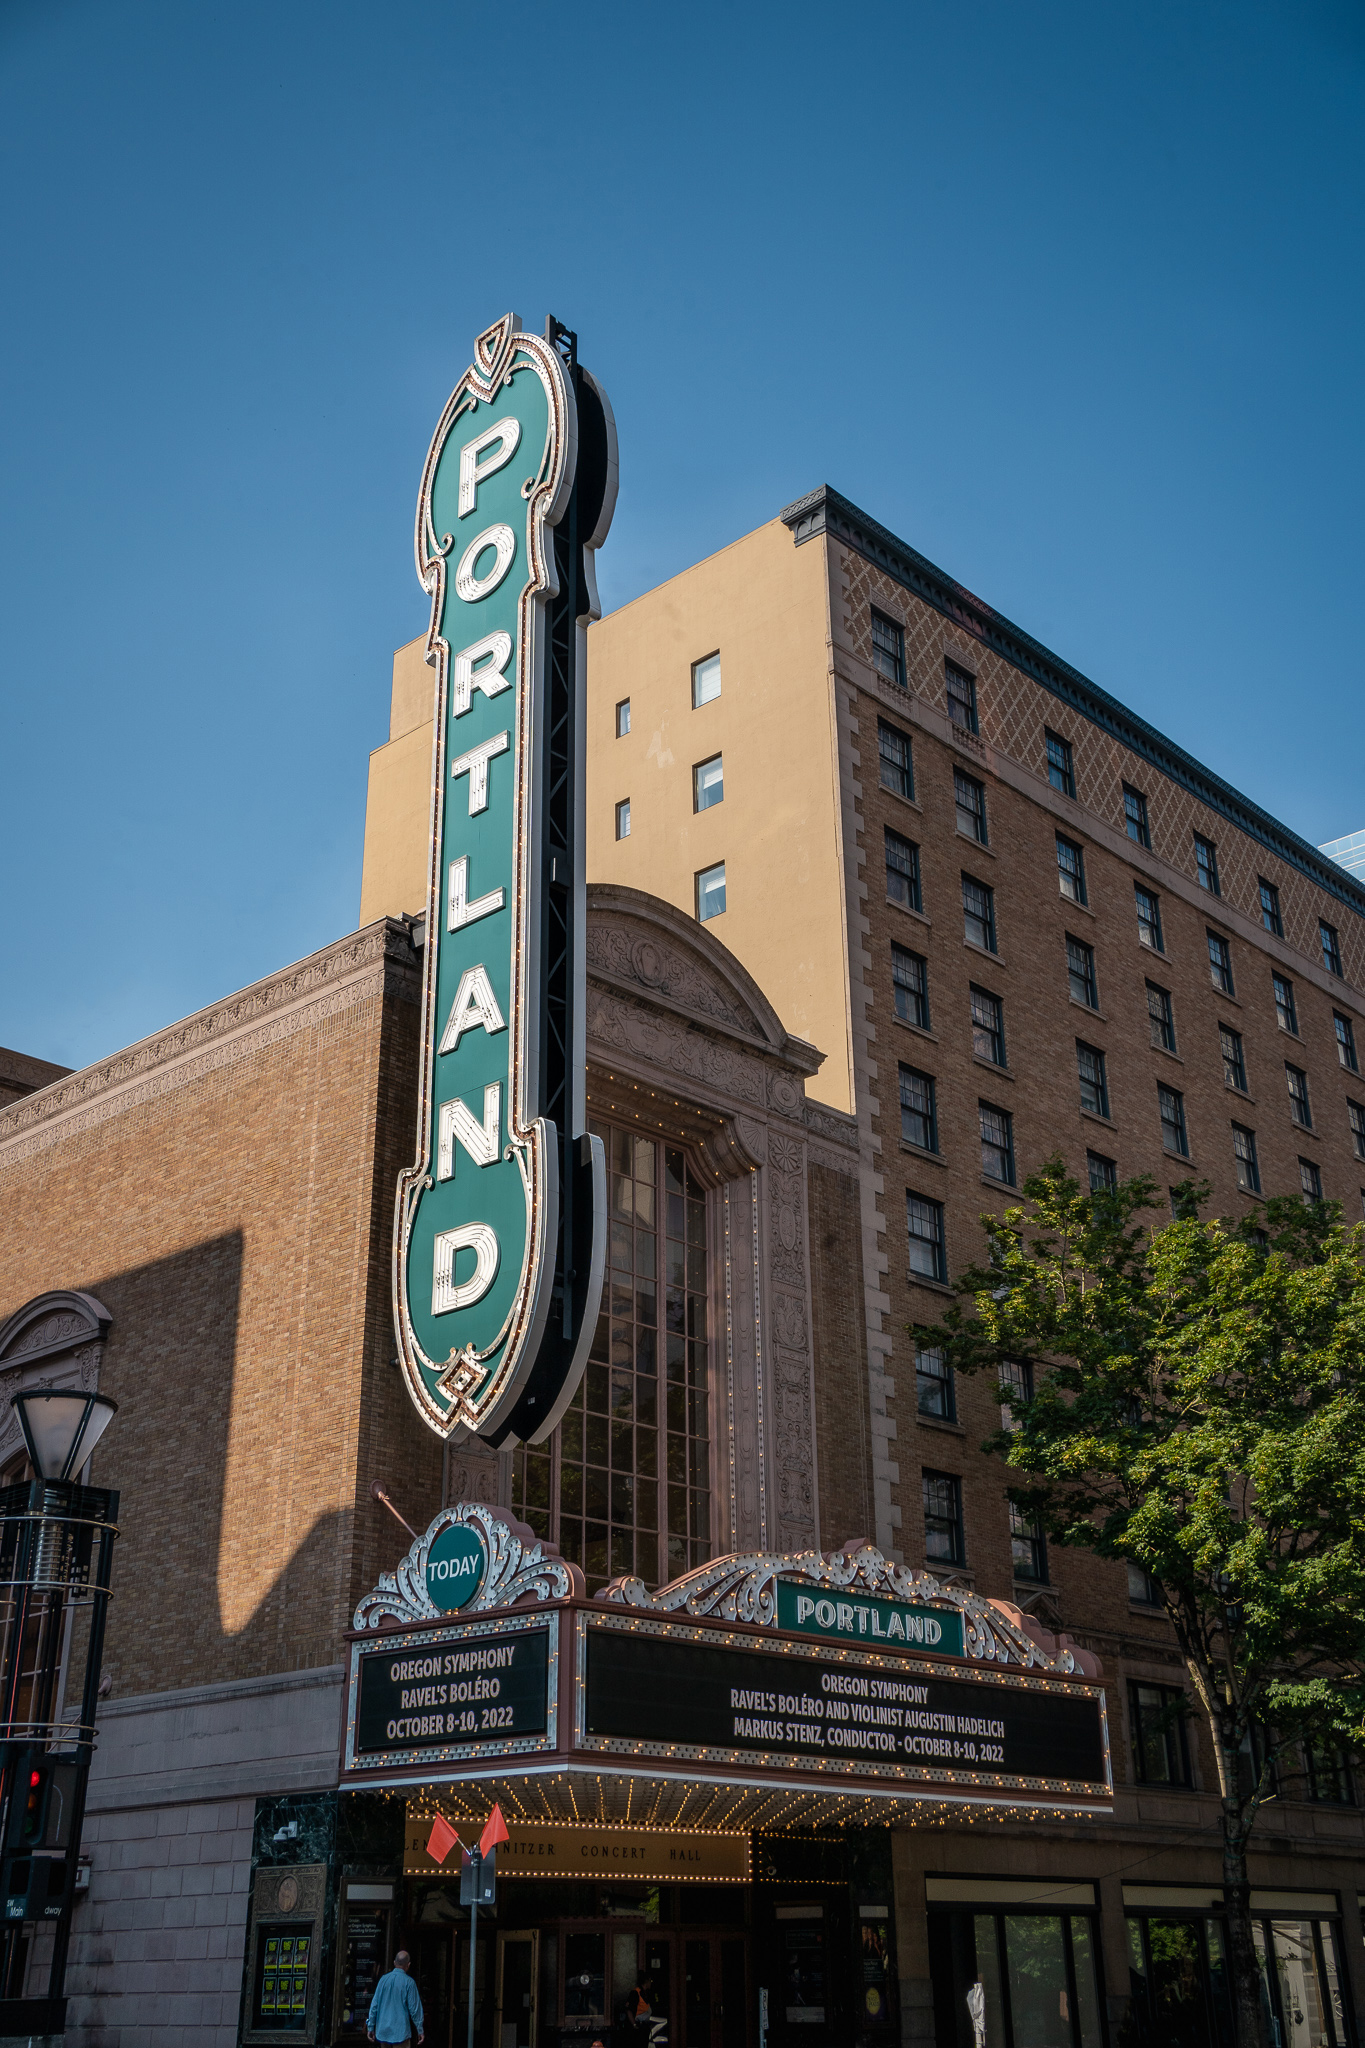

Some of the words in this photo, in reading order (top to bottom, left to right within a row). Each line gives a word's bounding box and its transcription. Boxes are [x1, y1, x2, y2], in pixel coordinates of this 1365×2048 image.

[430, 416, 522, 1315] PORTLAND
[428, 1553, 480, 1581] TODAY
[797, 1595, 943, 1645] PORTLAND
[390, 1656, 442, 1682] OREGON
[443, 1646, 515, 1674] SYMPHONY
[401, 1684, 447, 1709] RAVEL'S
[449, 1675, 500, 1702] BOLÉRO
[821, 1673, 869, 1697] OREGON
[870, 1680, 928, 1704] SYMPHONY
[387, 1714, 444, 1739] OCTOBER
[446, 1711, 478, 1733] 8-10,
[481, 1706, 513, 1729] 2022
[730, 1688, 776, 1712] RAVEL'S
[778, 1692, 824, 1718] BOLÉRO
[826, 1701, 849, 1720] AND
[851, 1704, 903, 1728] VIOLINIST
[905, 1710, 955, 1733] AUGUSTIN
[957, 1716, 1005, 1738] HADELICH
[734, 1717, 783, 1741] MARKUS
[785, 1723, 825, 1747] STENZ,
[827, 1727, 896, 1752] CONDUCTOR
[904, 1738, 951, 1757] OCTOBER
[953, 1741, 979, 1762] 8-10,
[980, 1745, 1004, 1763] 2022
[580, 1845, 646, 1860] CONCERT
[670, 1848, 701, 1861] HALL
[10, 1906, 23, 1917] Main
